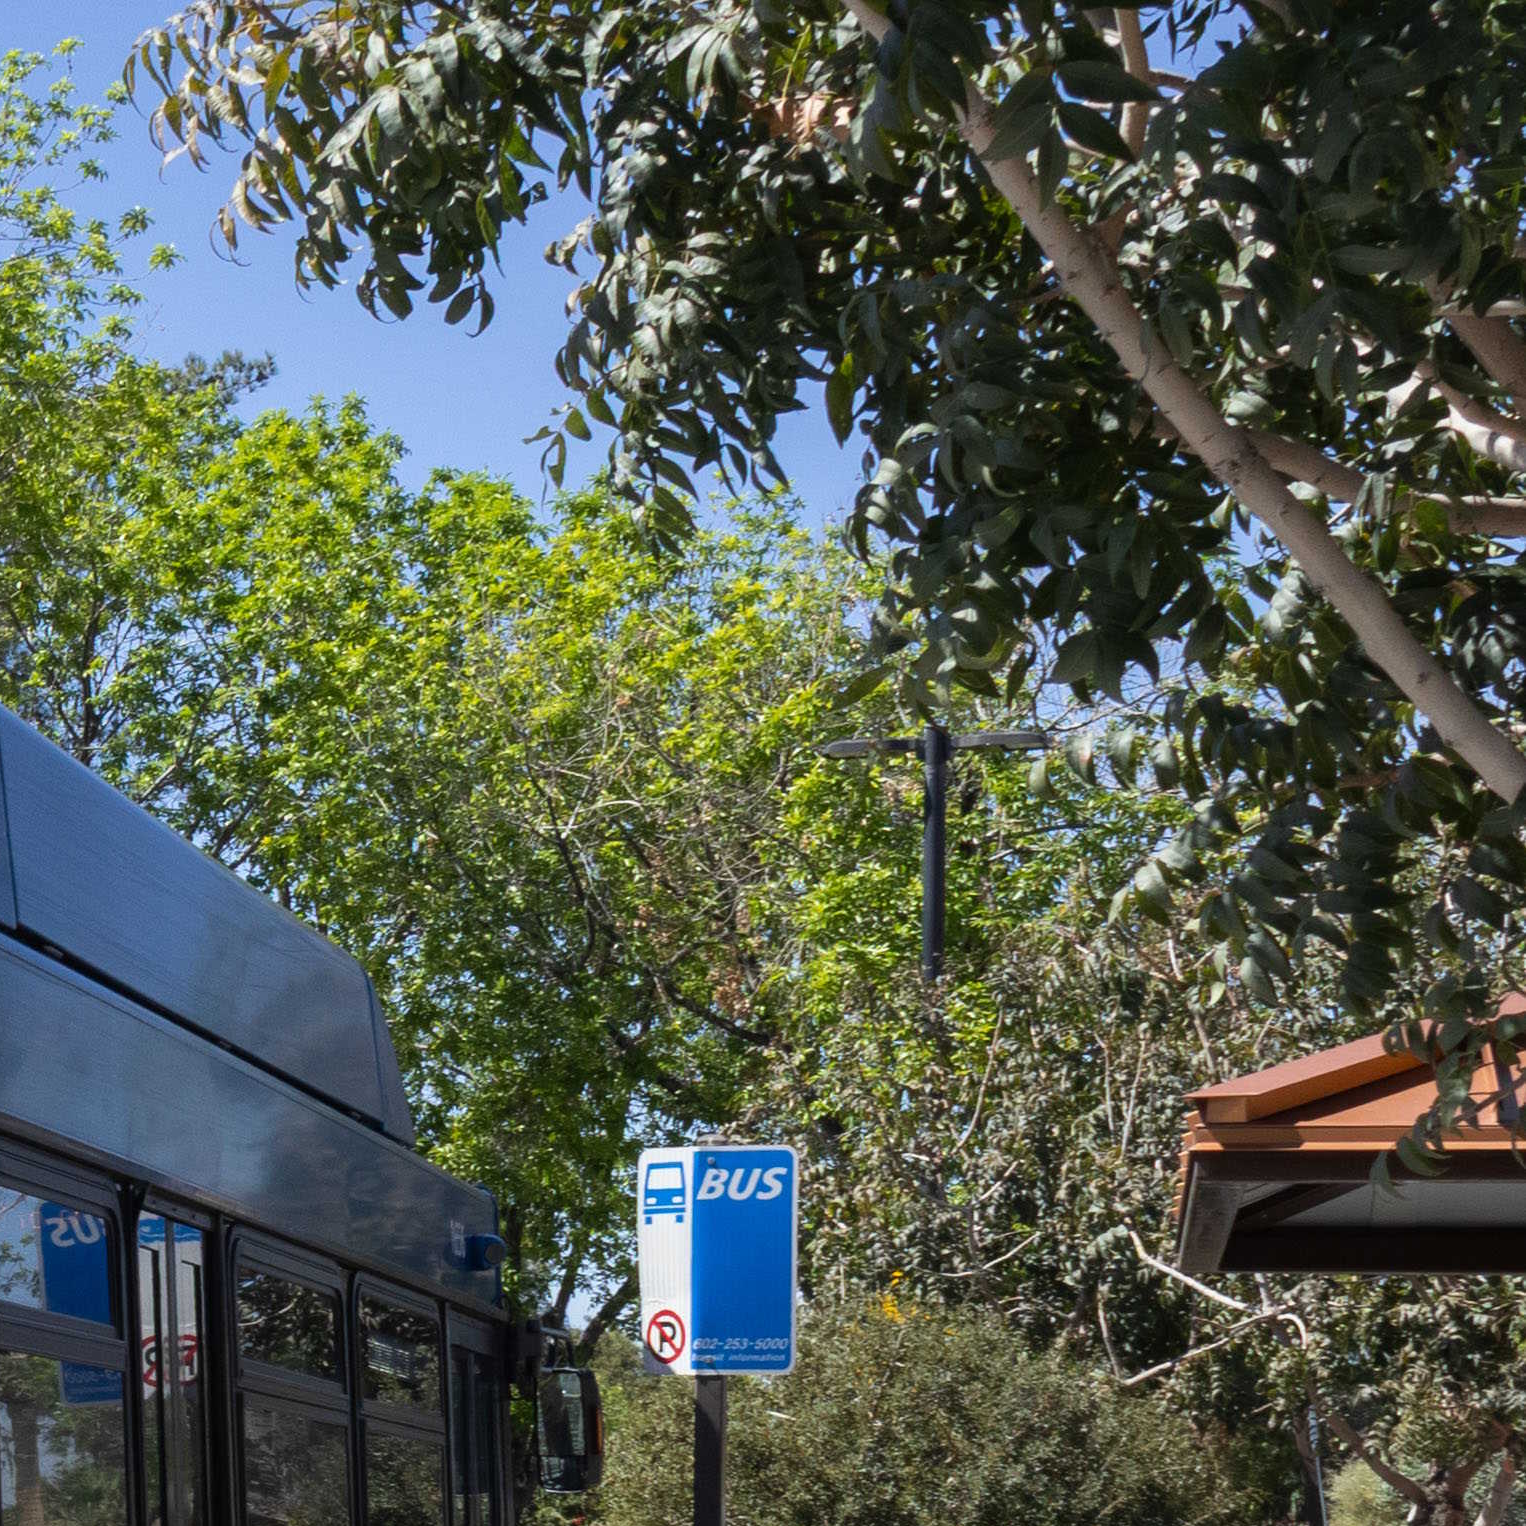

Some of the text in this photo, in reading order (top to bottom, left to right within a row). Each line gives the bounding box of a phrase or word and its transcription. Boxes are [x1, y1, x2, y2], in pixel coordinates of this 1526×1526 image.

[696, 1167, 788, 1201] BUS
[692, 1337, 789, 1350] 602-253-5000
[728, 1353, 786, 1362] information
